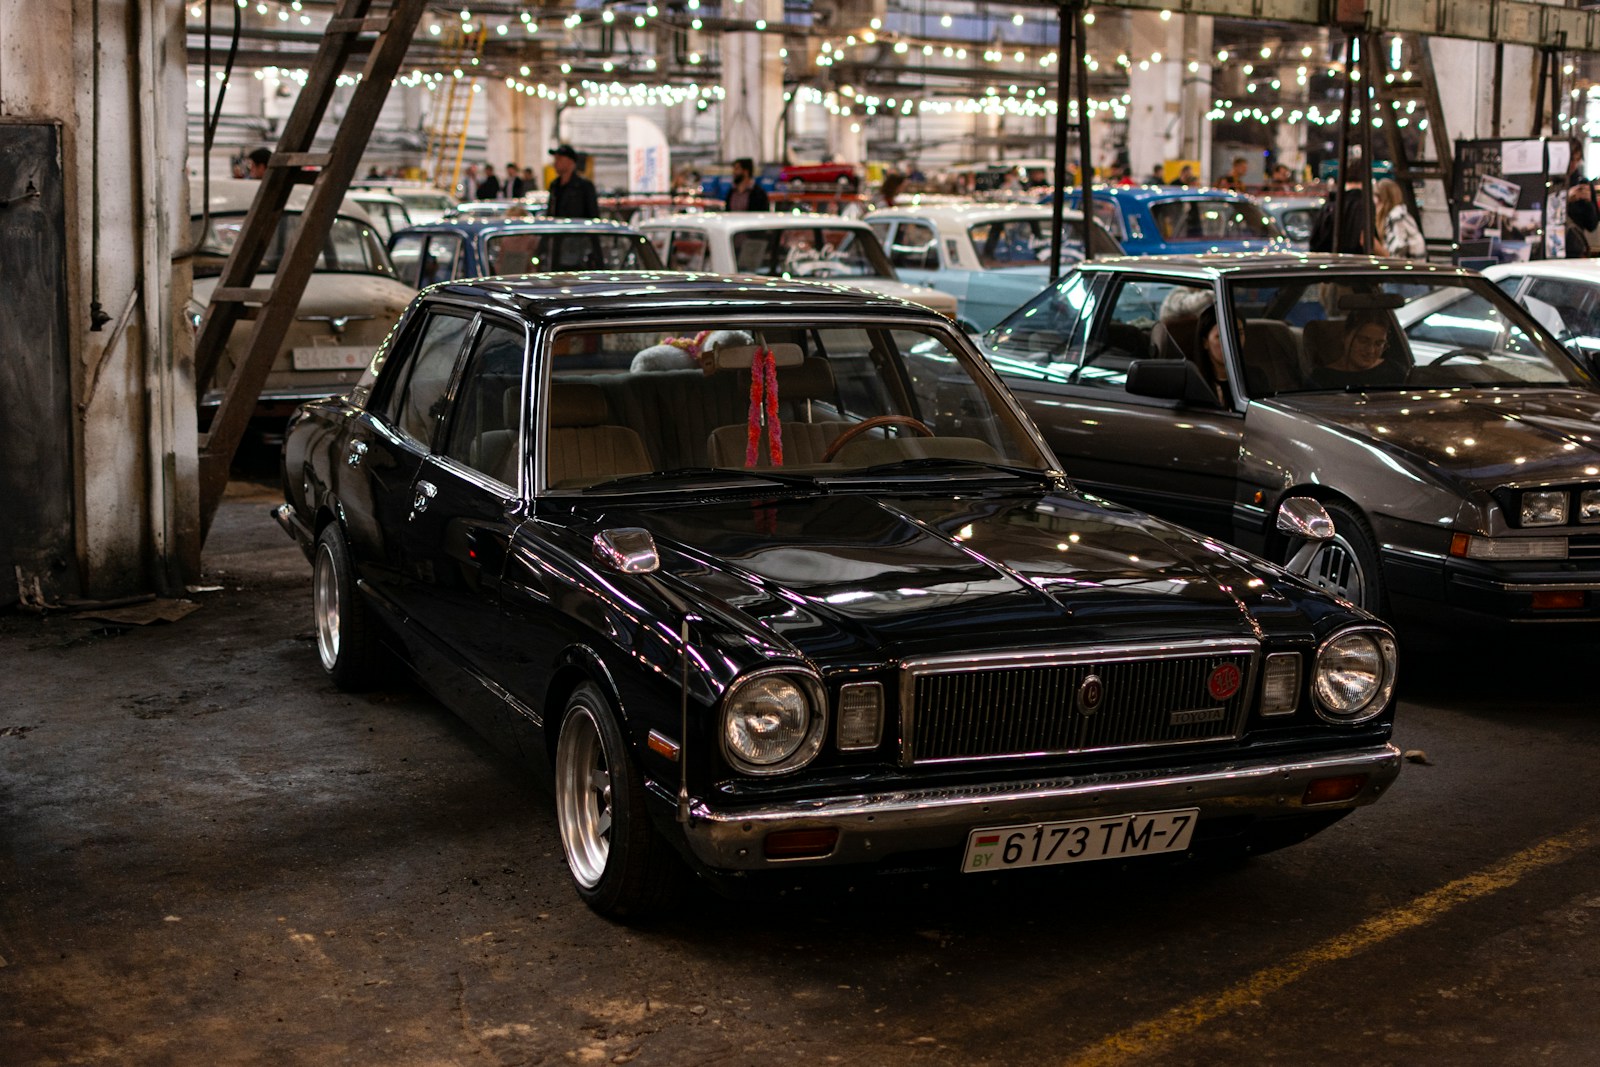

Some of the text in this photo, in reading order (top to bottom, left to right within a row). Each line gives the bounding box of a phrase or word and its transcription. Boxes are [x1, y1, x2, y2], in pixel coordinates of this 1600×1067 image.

[1173, 709, 1221, 723] TOYOTA
[1002, 815, 1192, 864] 6173 TM-7
[972, 852, 994, 868] BY
